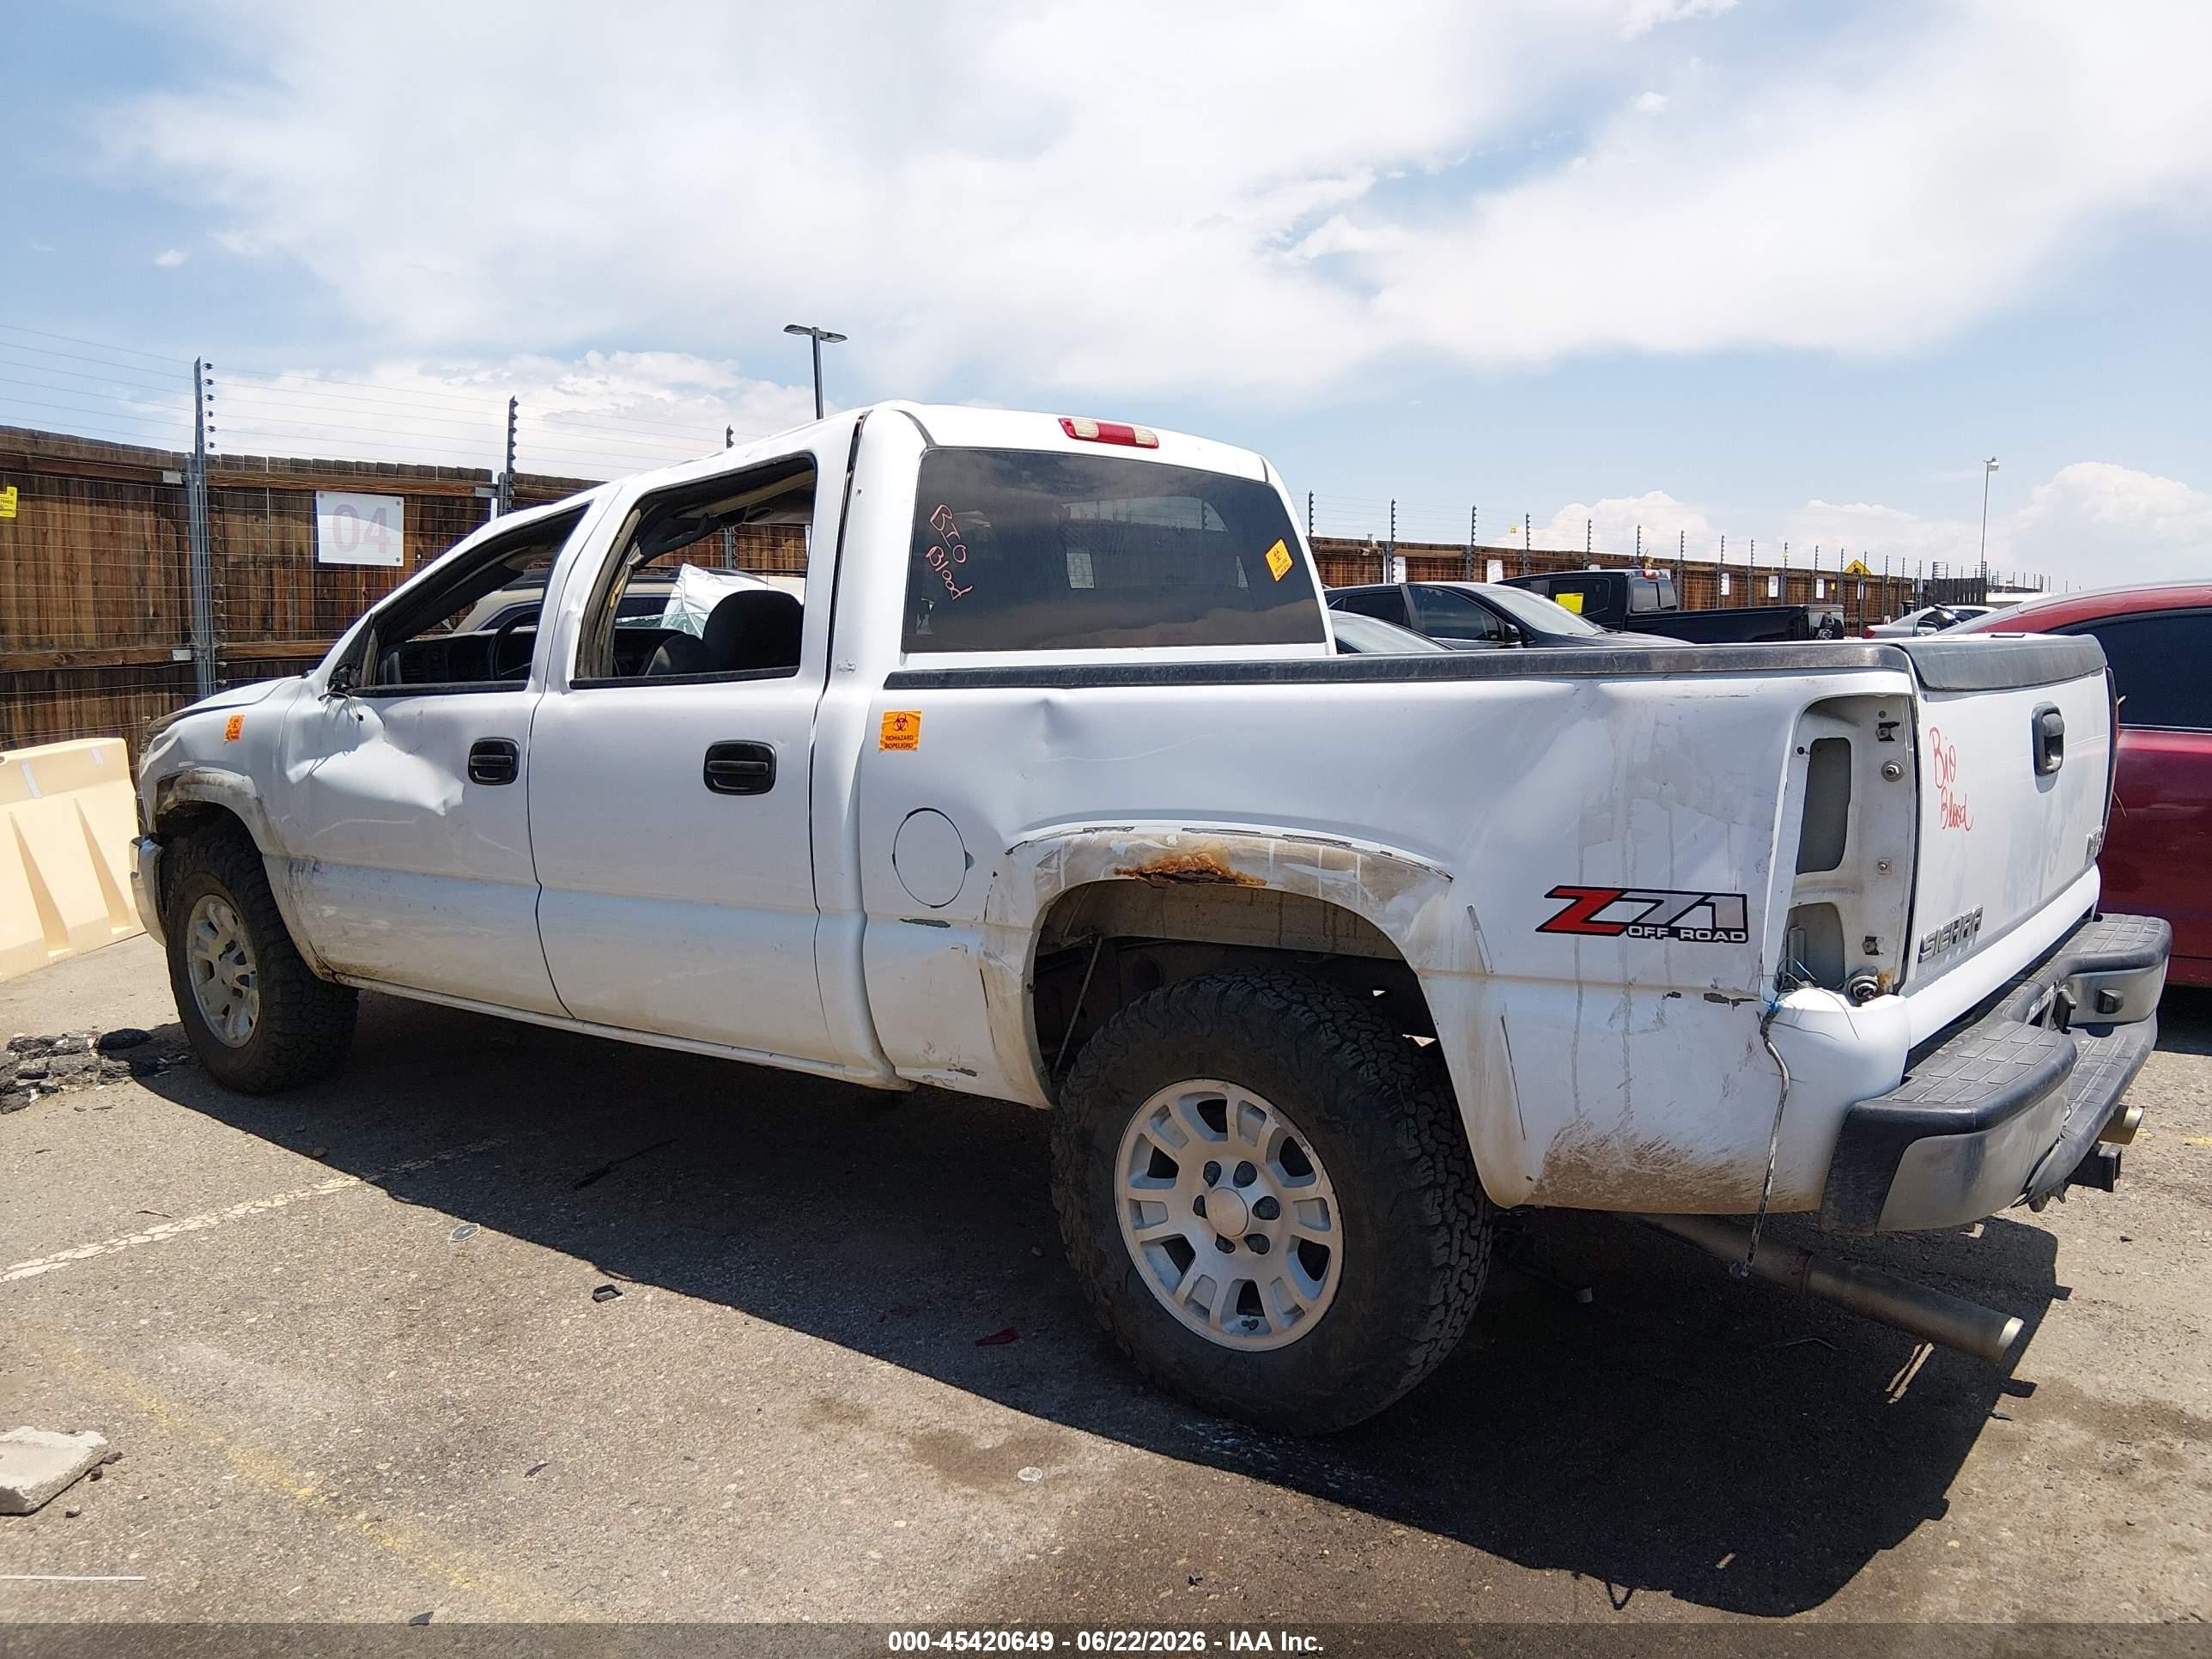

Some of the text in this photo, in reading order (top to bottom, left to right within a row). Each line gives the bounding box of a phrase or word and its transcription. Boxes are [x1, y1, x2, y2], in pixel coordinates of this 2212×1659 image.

[332, 504, 391, 554] 04
[930, 504, 967, 563] BIO
[926, 545, 973, 600] Blood
[1940, 786, 1974, 832] Blood
[1535, 884, 1748, 937] Z71
[1627, 926, 1747, 942] OFF ROAD
[1918, 904, 1984, 963] SIERRA
